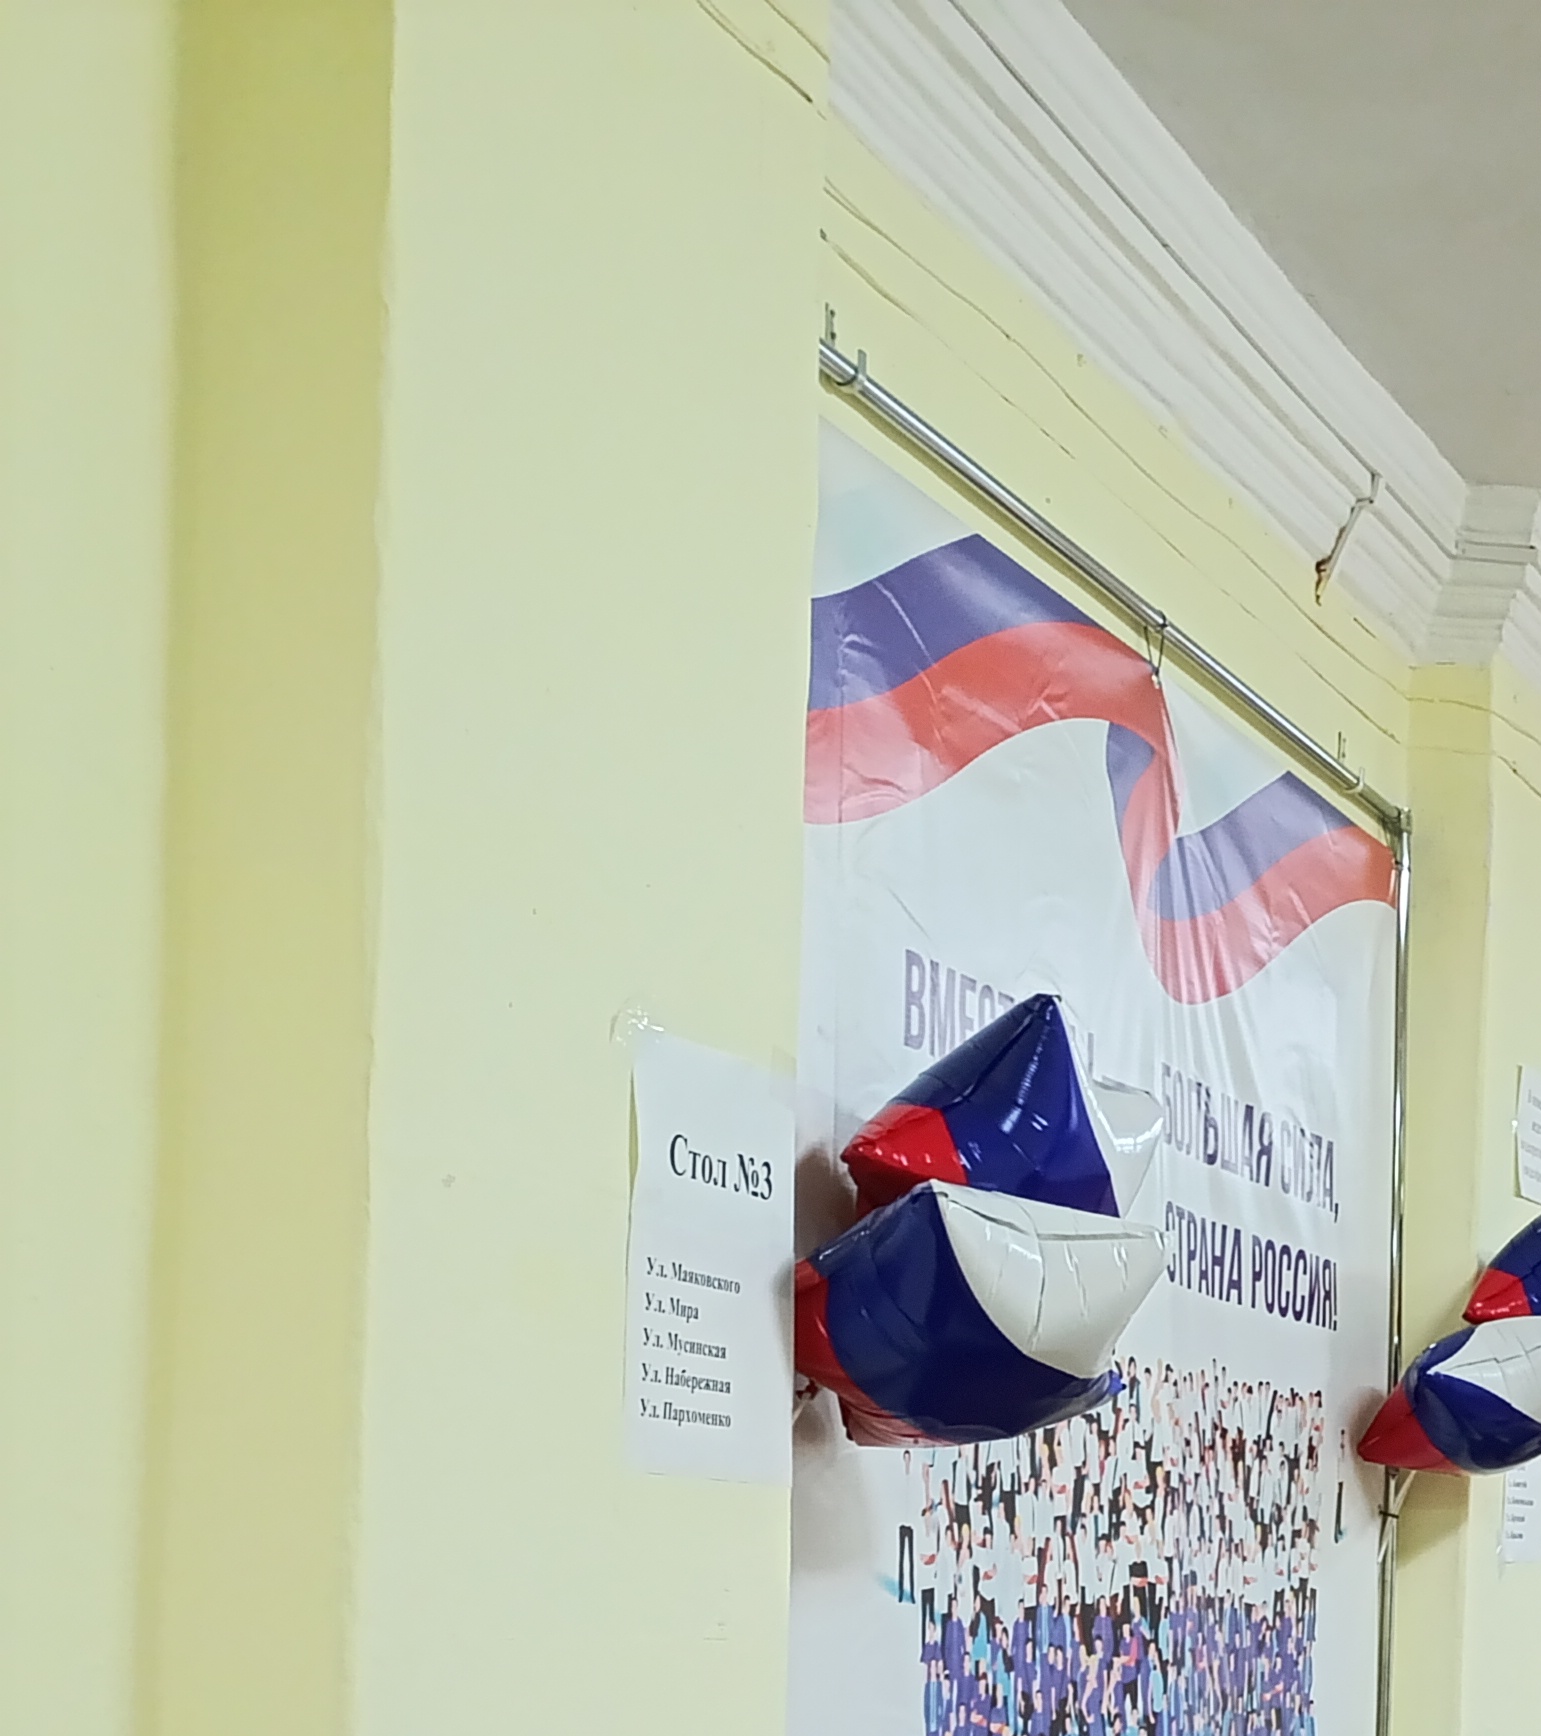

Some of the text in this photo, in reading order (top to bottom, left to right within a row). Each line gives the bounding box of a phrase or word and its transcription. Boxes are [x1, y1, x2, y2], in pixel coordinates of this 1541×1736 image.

[1161, 1061, 1339, 1224] БОЛЬШАЯ СИЛА,
[669, 1133, 773, 1201] Стол №3
[646, 1256, 741, 1294] Ул. Маяковского
[1165, 1200, 1339, 1332] СТРАНА РОССИЯ!
[645, 1292, 699, 1324] Ул. Мира
[643, 1327, 664, 1349] Ул.
[641, 1362, 731, 1394] Ул. Набережная
[640, 1398, 732, 1427] Ул. Пархоменко
